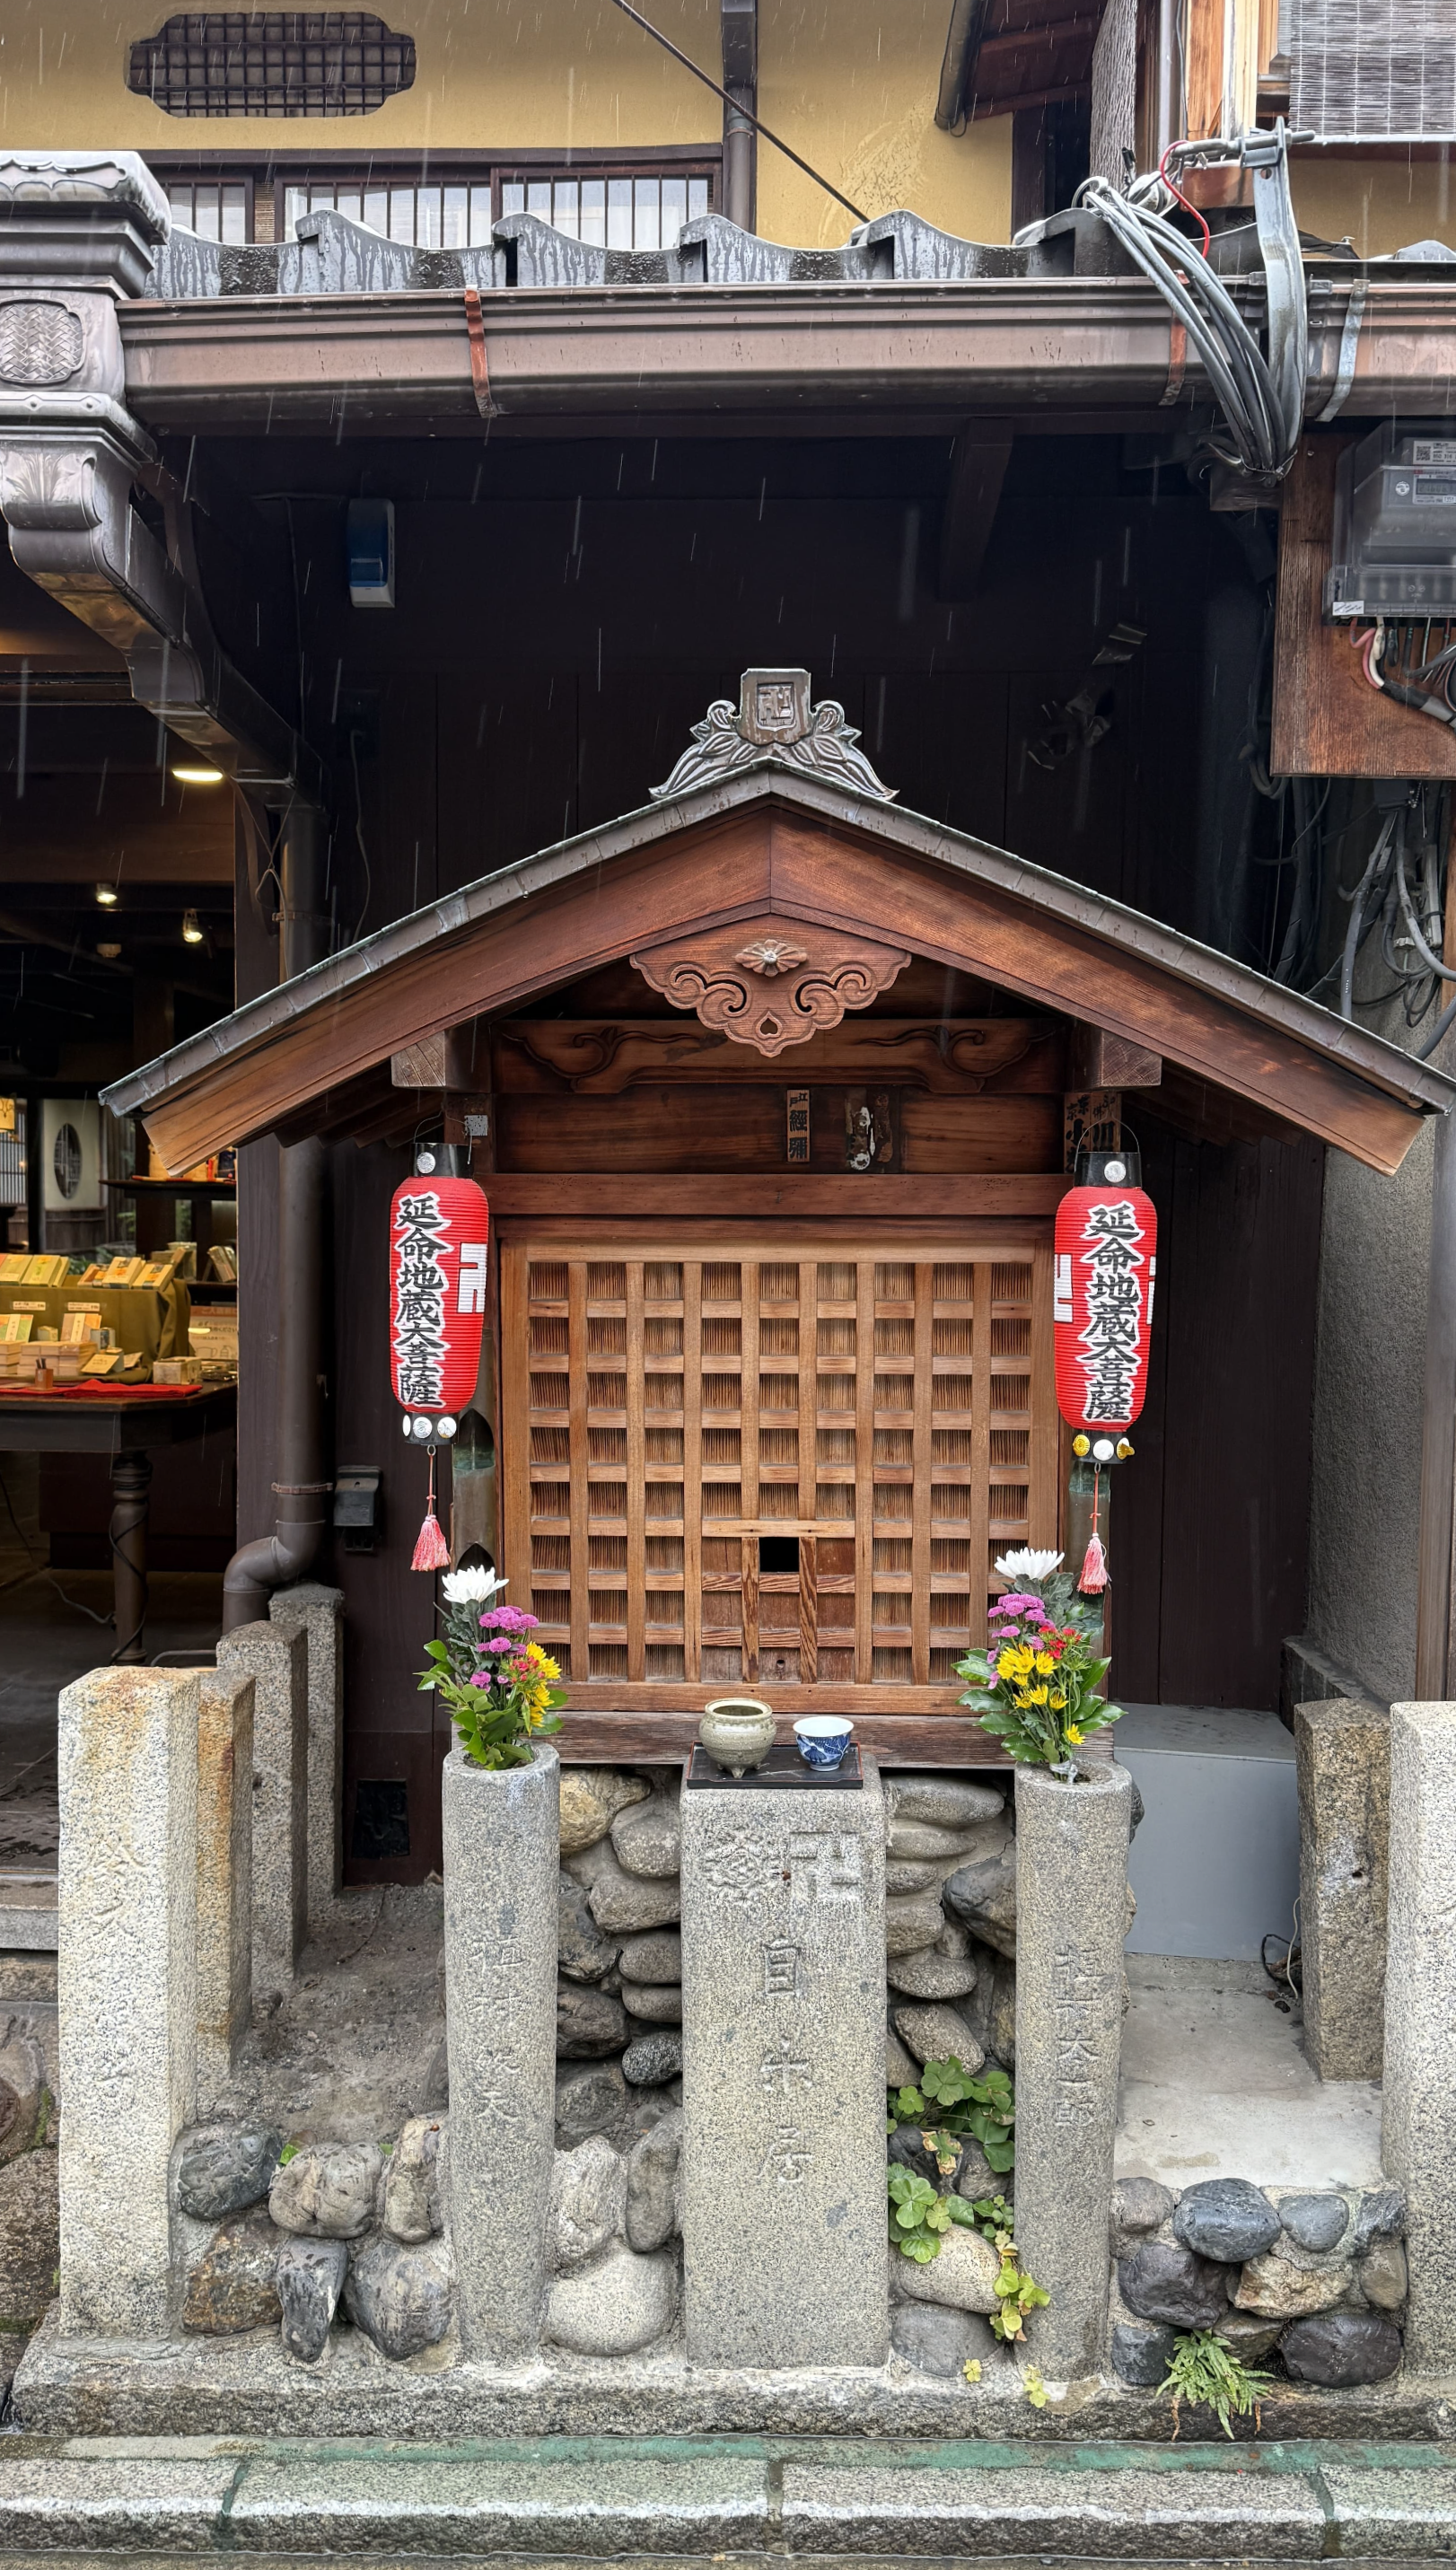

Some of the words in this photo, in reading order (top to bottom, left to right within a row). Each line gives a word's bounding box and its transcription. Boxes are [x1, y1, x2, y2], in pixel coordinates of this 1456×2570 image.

[395, 1194, 452, 1407] 延命地蔵大菩薩
[1080, 1203, 1142, 1422] 延命地蔵大菩薩
